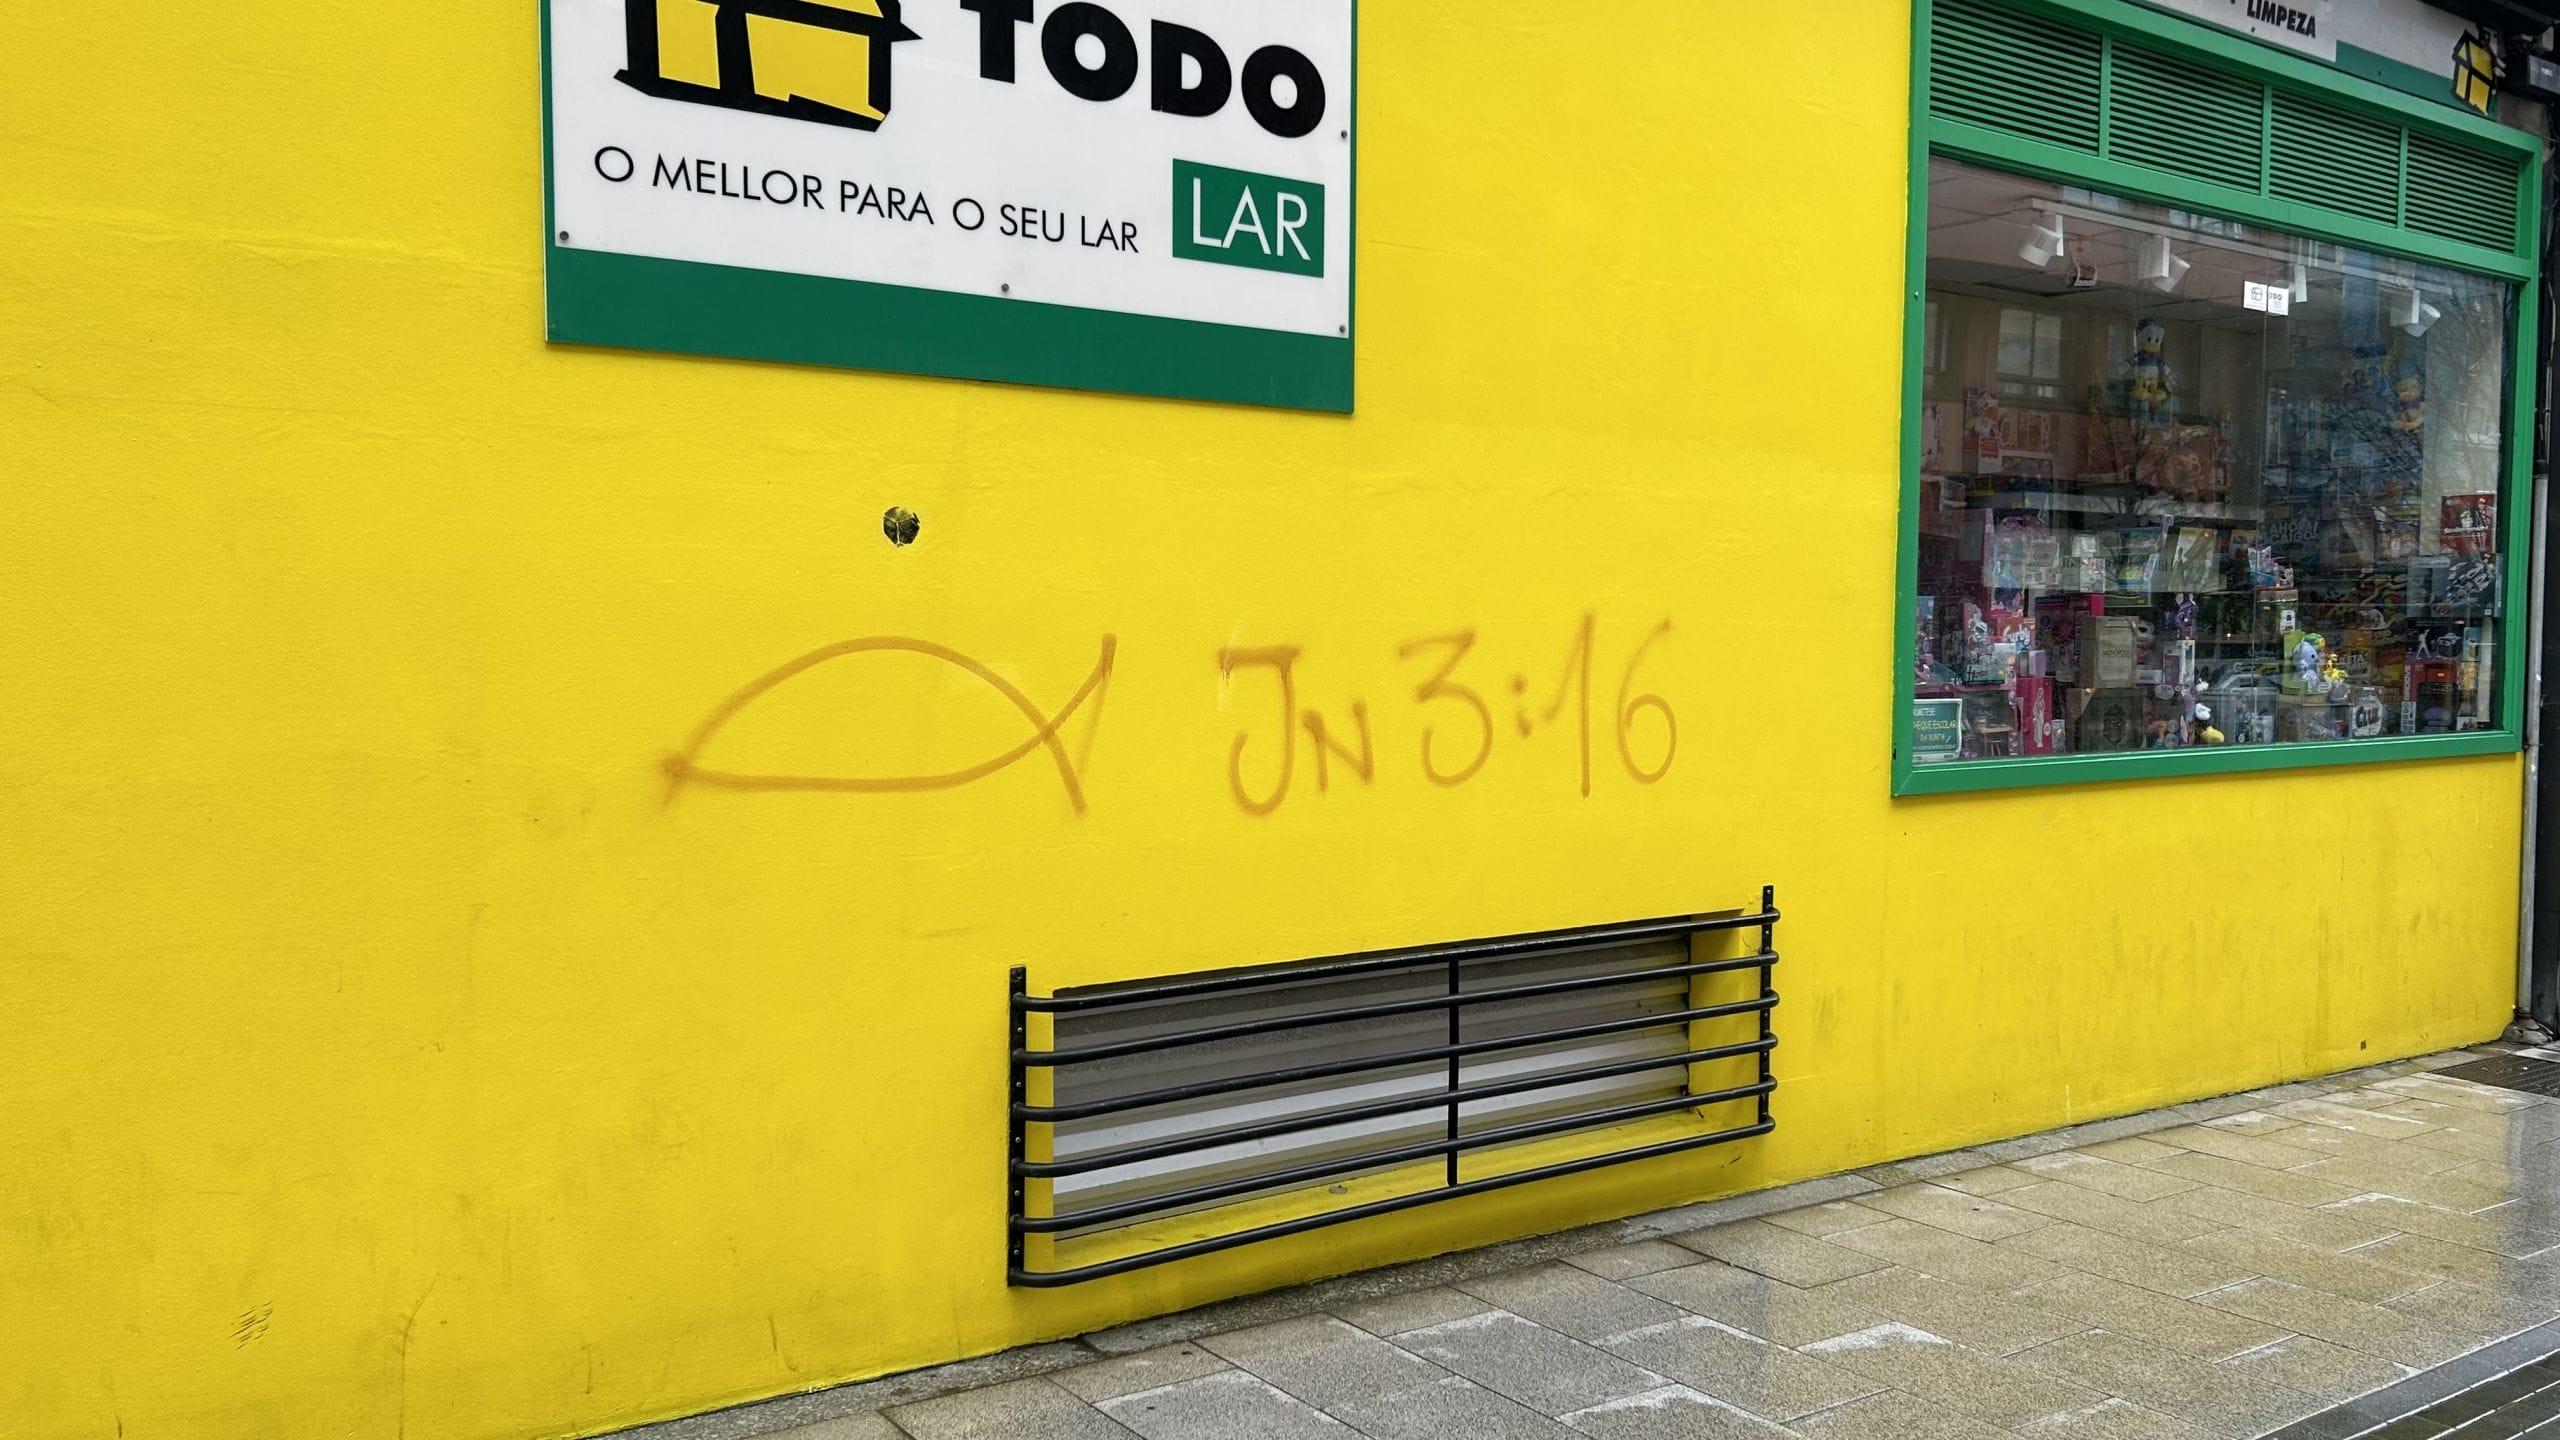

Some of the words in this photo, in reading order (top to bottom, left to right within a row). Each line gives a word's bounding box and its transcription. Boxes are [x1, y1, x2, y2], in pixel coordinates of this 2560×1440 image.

[960, 0, 1326, 139] TODO
[2247, 0, 2316, 38] LIMPEZA
[595, 146, 635, 183] O
[653, 154, 826, 212] MELLOR
[841, 180, 936, 225] PARA
[953, 198, 985, 231] O
[1000, 204, 1065, 243] SEU
[1082, 216, 1140, 253] LAR
[1193, 178, 1311, 261] LAR
[1399, 609, 1678, 799] 3:16
